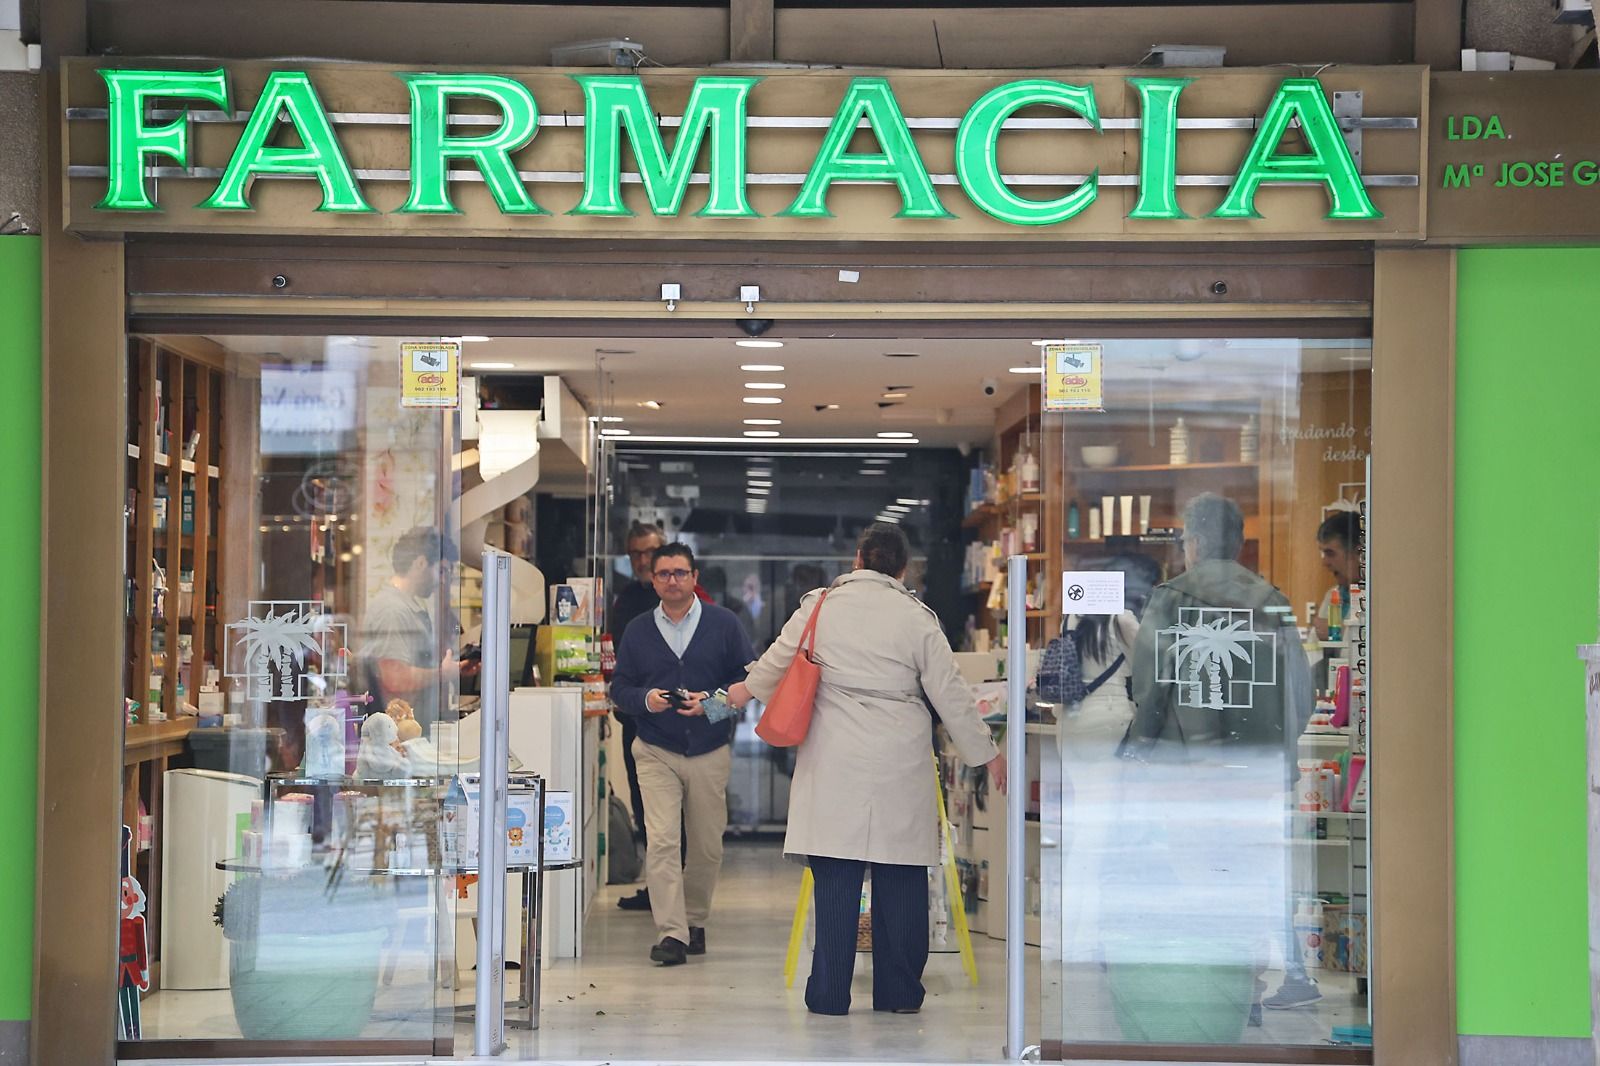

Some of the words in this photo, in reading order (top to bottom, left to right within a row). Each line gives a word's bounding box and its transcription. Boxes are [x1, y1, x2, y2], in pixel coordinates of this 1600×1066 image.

[93, 66, 1383, 225] FARMACIA
[1447, 115, 1512, 141] LDA.
[1494, 153, 1565, 188] JOSÉ
[1572, 160, 1600, 186] G
